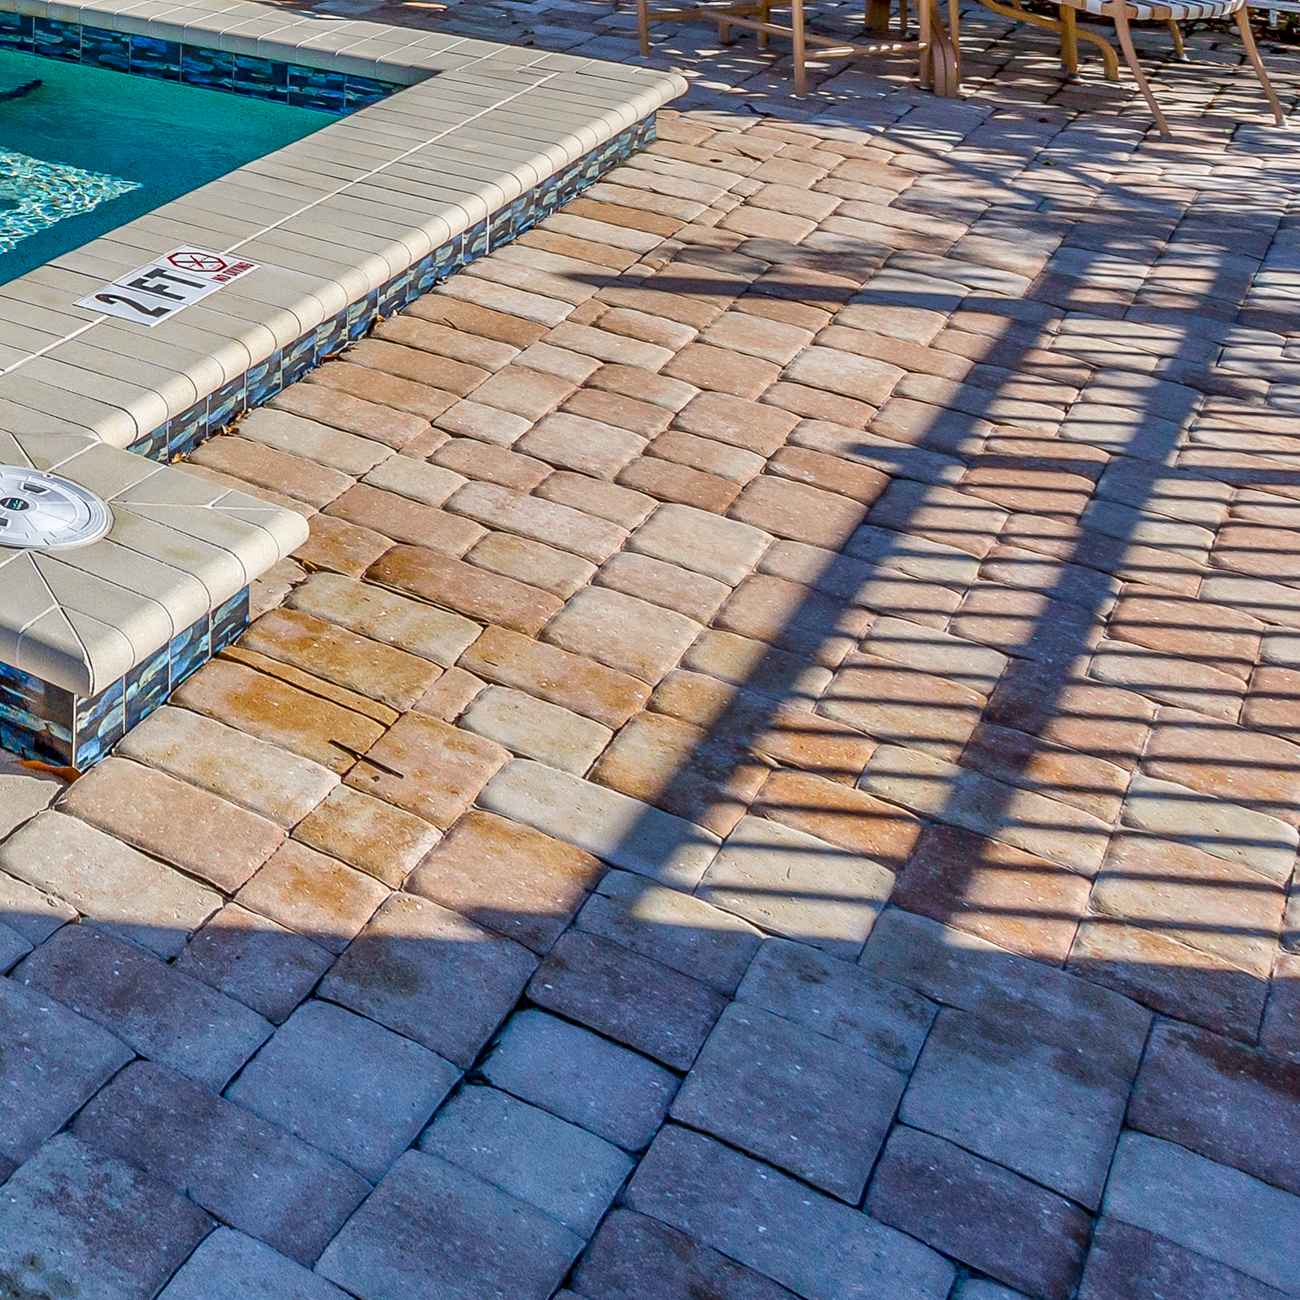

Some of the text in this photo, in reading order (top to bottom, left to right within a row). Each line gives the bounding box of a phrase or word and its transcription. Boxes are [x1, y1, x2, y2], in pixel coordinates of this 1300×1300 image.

[211, 262, 255, 282] NO DIVING
[95, 268, 206, 318] 2 FT
